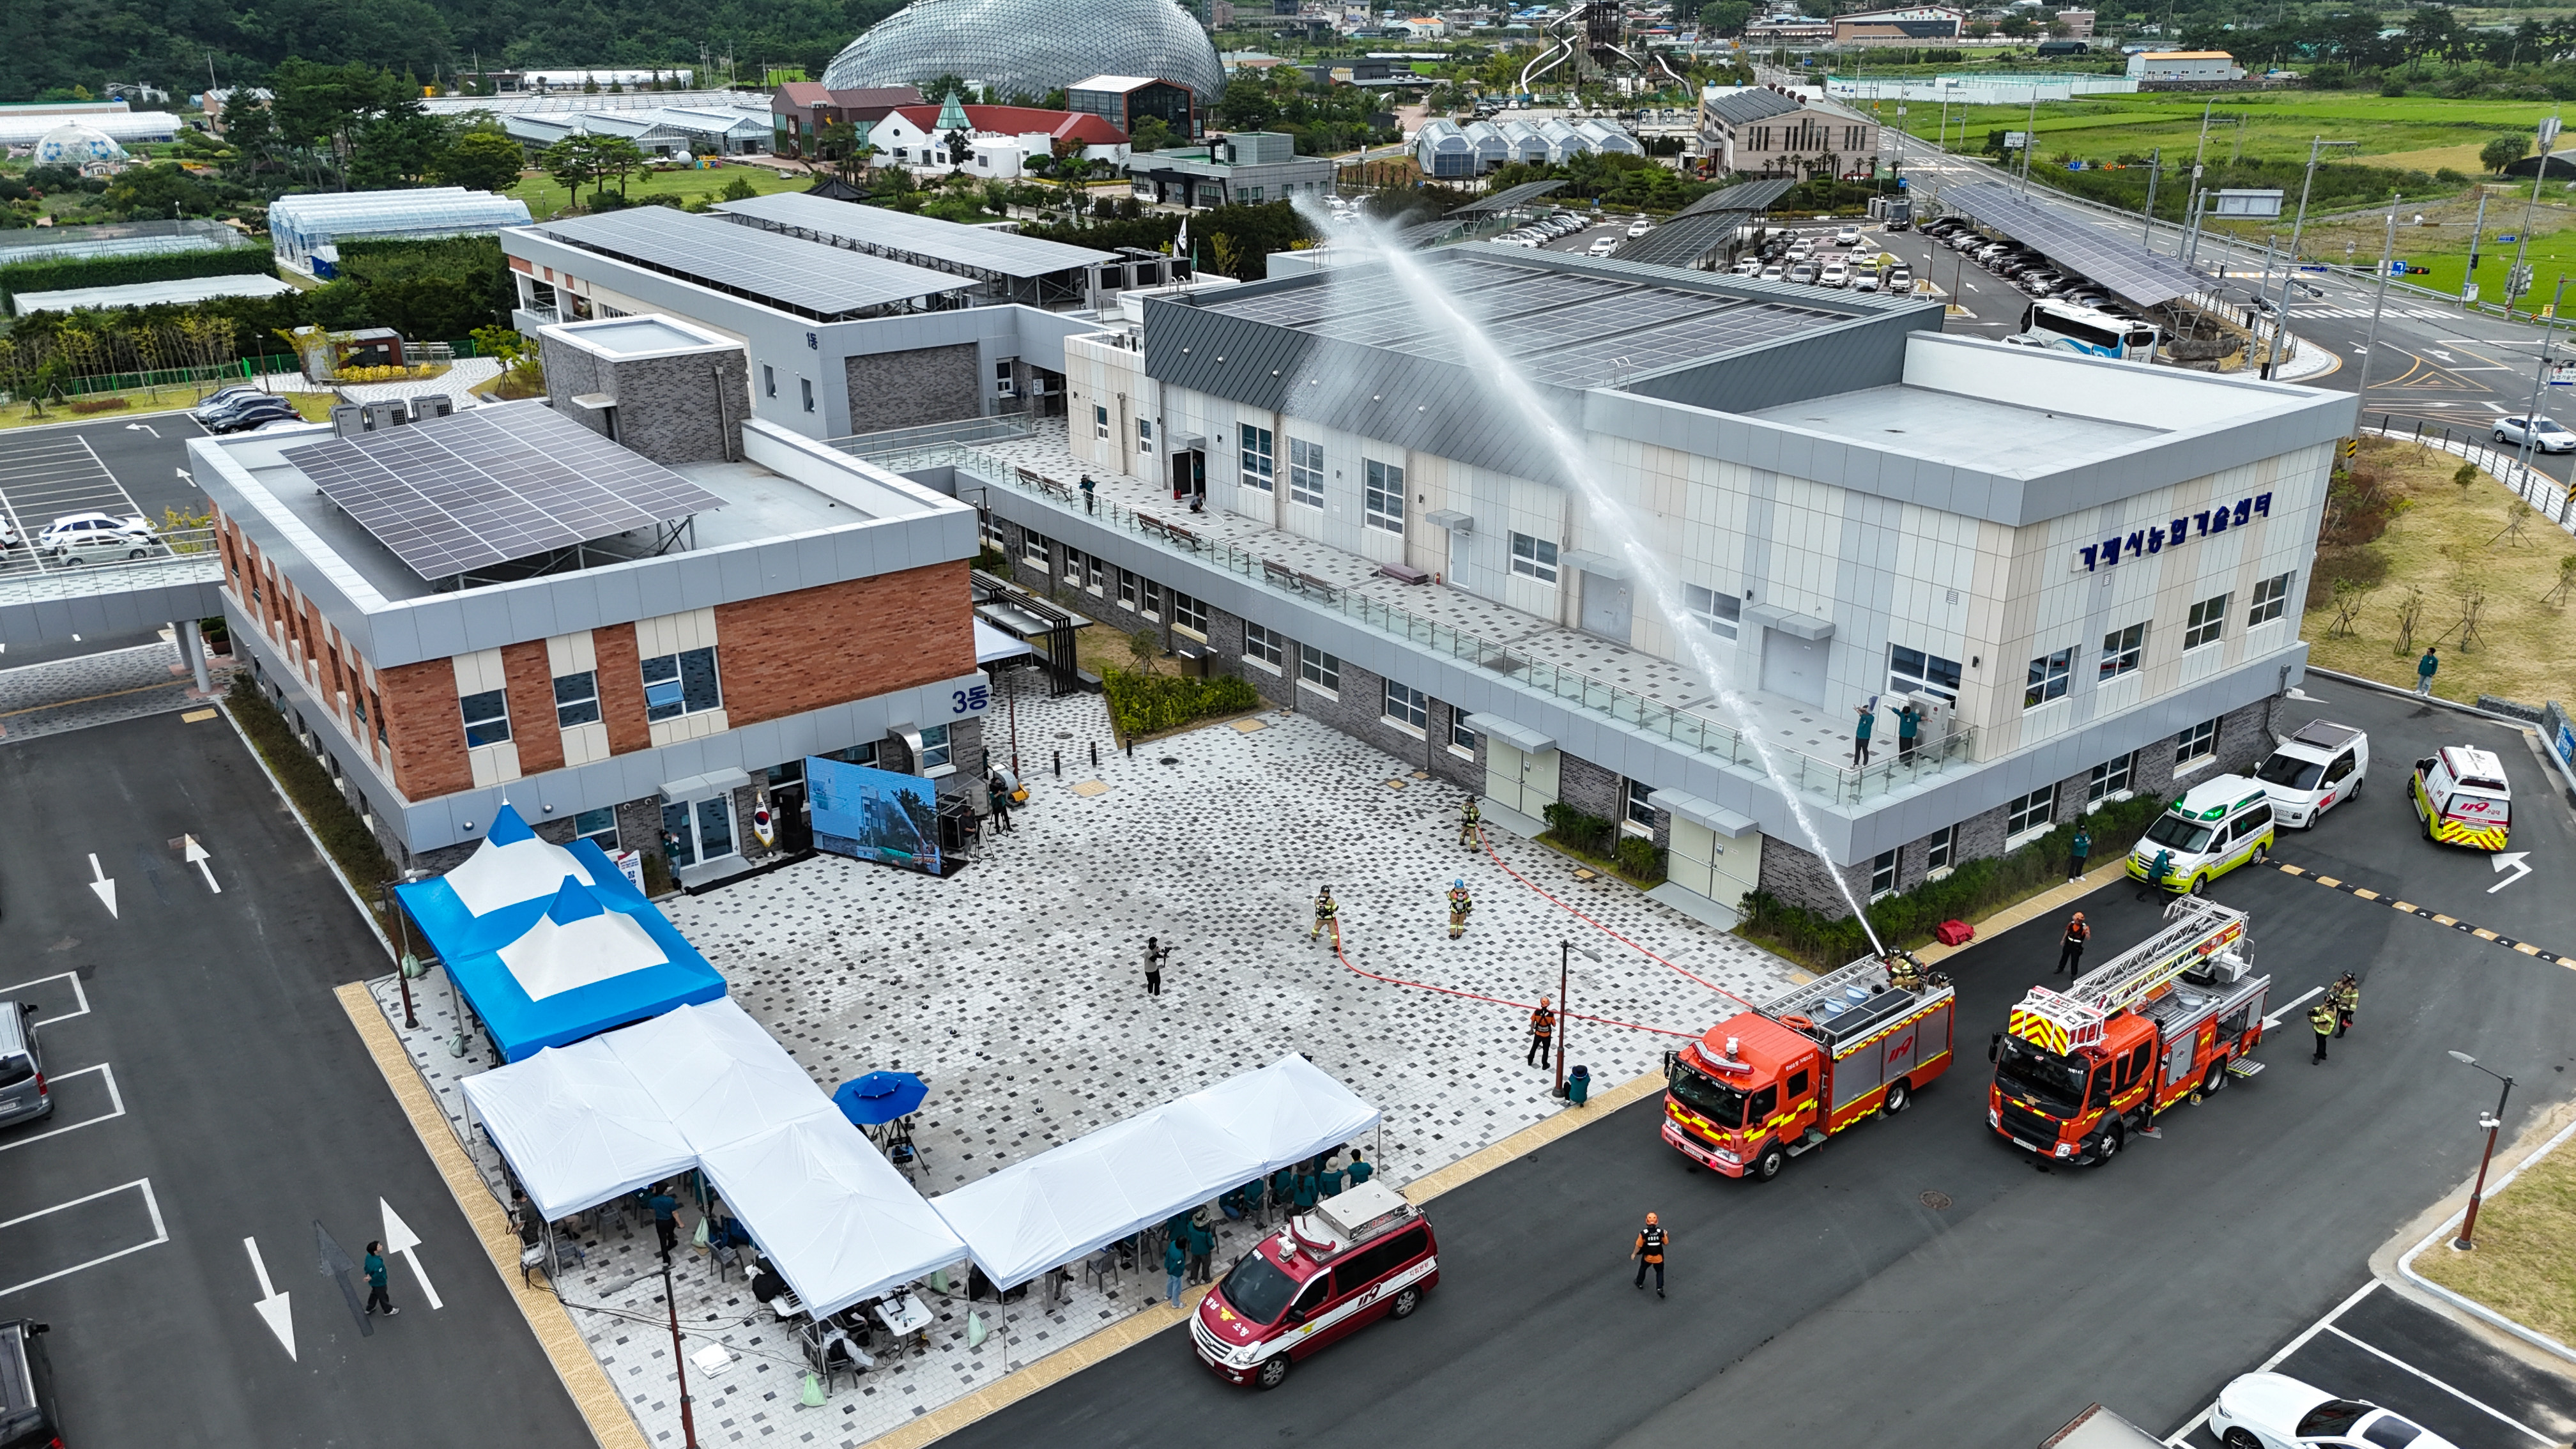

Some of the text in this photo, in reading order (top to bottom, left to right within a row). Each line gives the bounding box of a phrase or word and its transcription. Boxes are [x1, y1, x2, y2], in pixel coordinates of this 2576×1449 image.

[806, 332, 818, 350] 1동
[2080, 492, 2272, 572] 거제시농업기술센터
[953, 684, 989, 714] 3동
[2459, 802, 2490, 813] 119
[2239, 826, 2265, 844] AMBULANCE
[1887, 1035, 1913, 1064] 119
[1357, 1282, 1382, 1308] 119
